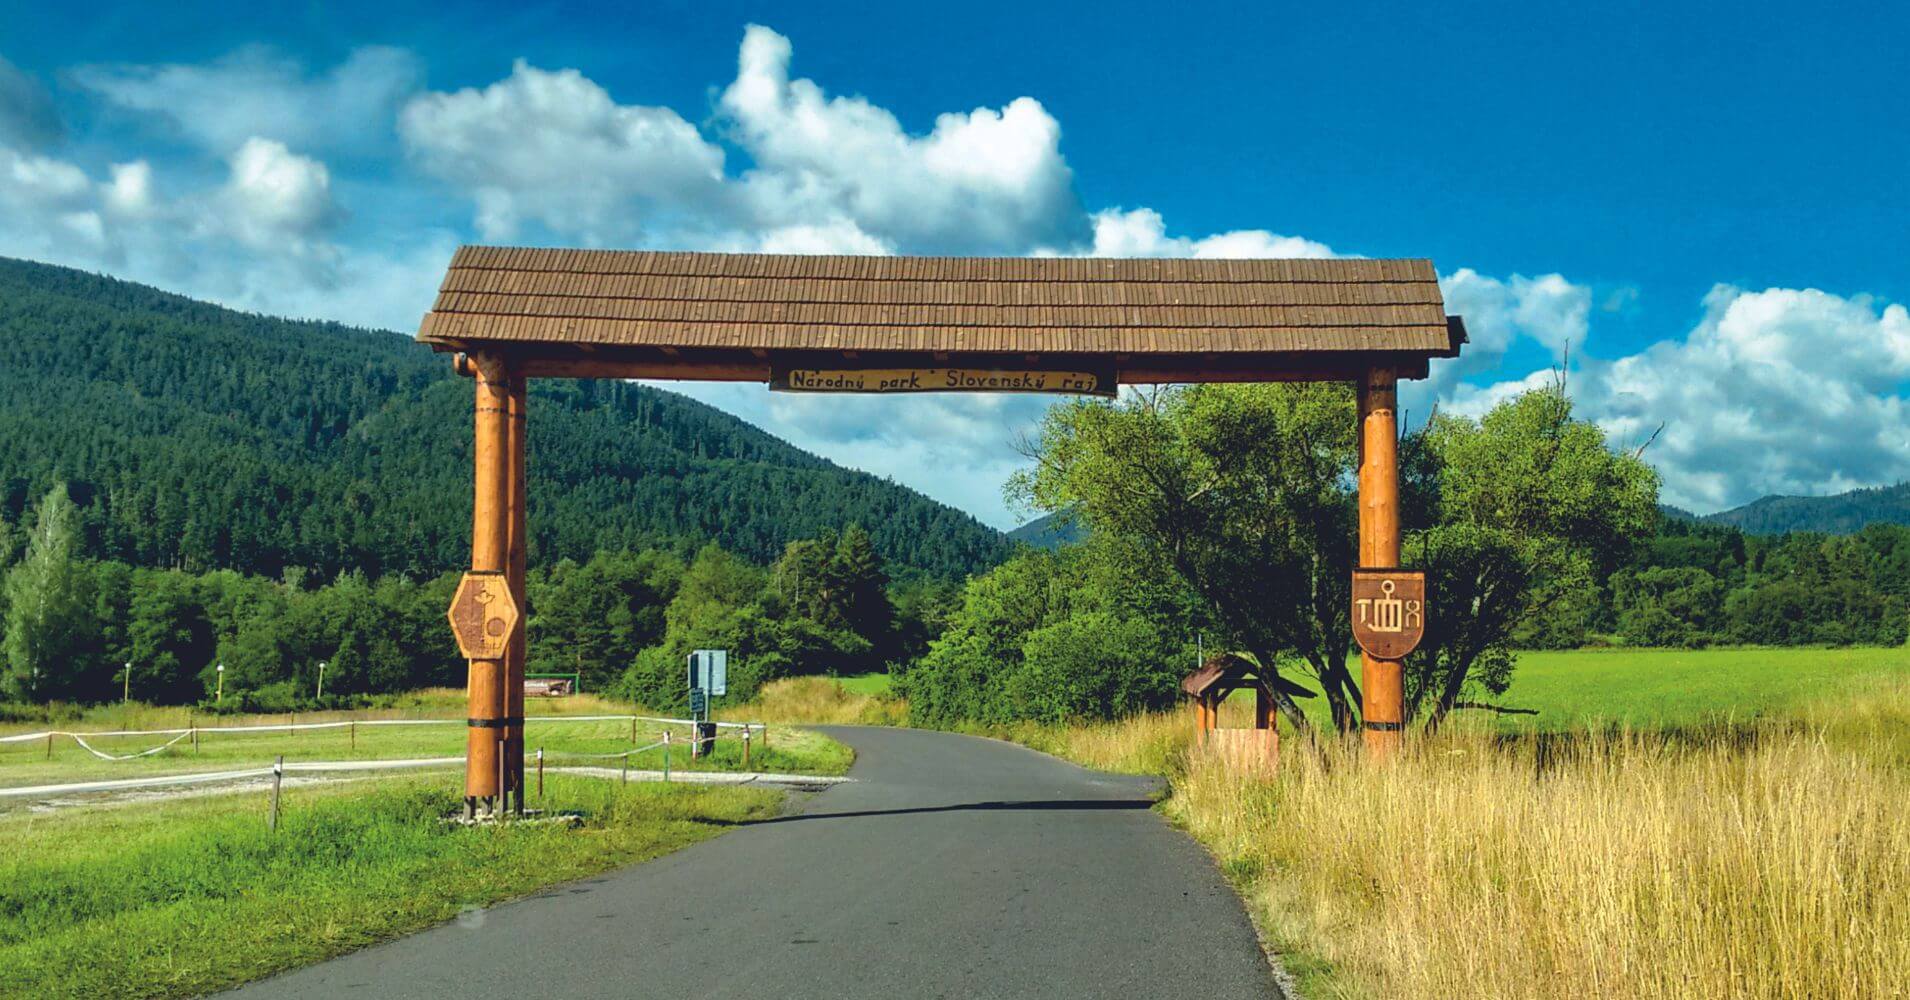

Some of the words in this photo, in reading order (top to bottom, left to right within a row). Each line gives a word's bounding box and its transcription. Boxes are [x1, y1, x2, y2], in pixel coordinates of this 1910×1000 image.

[793, 370, 864, 389] Národný
[880, 371, 921, 389] park
[946, 370, 1046, 389] Slovenský
[1062, 376, 1095, 391] raj
